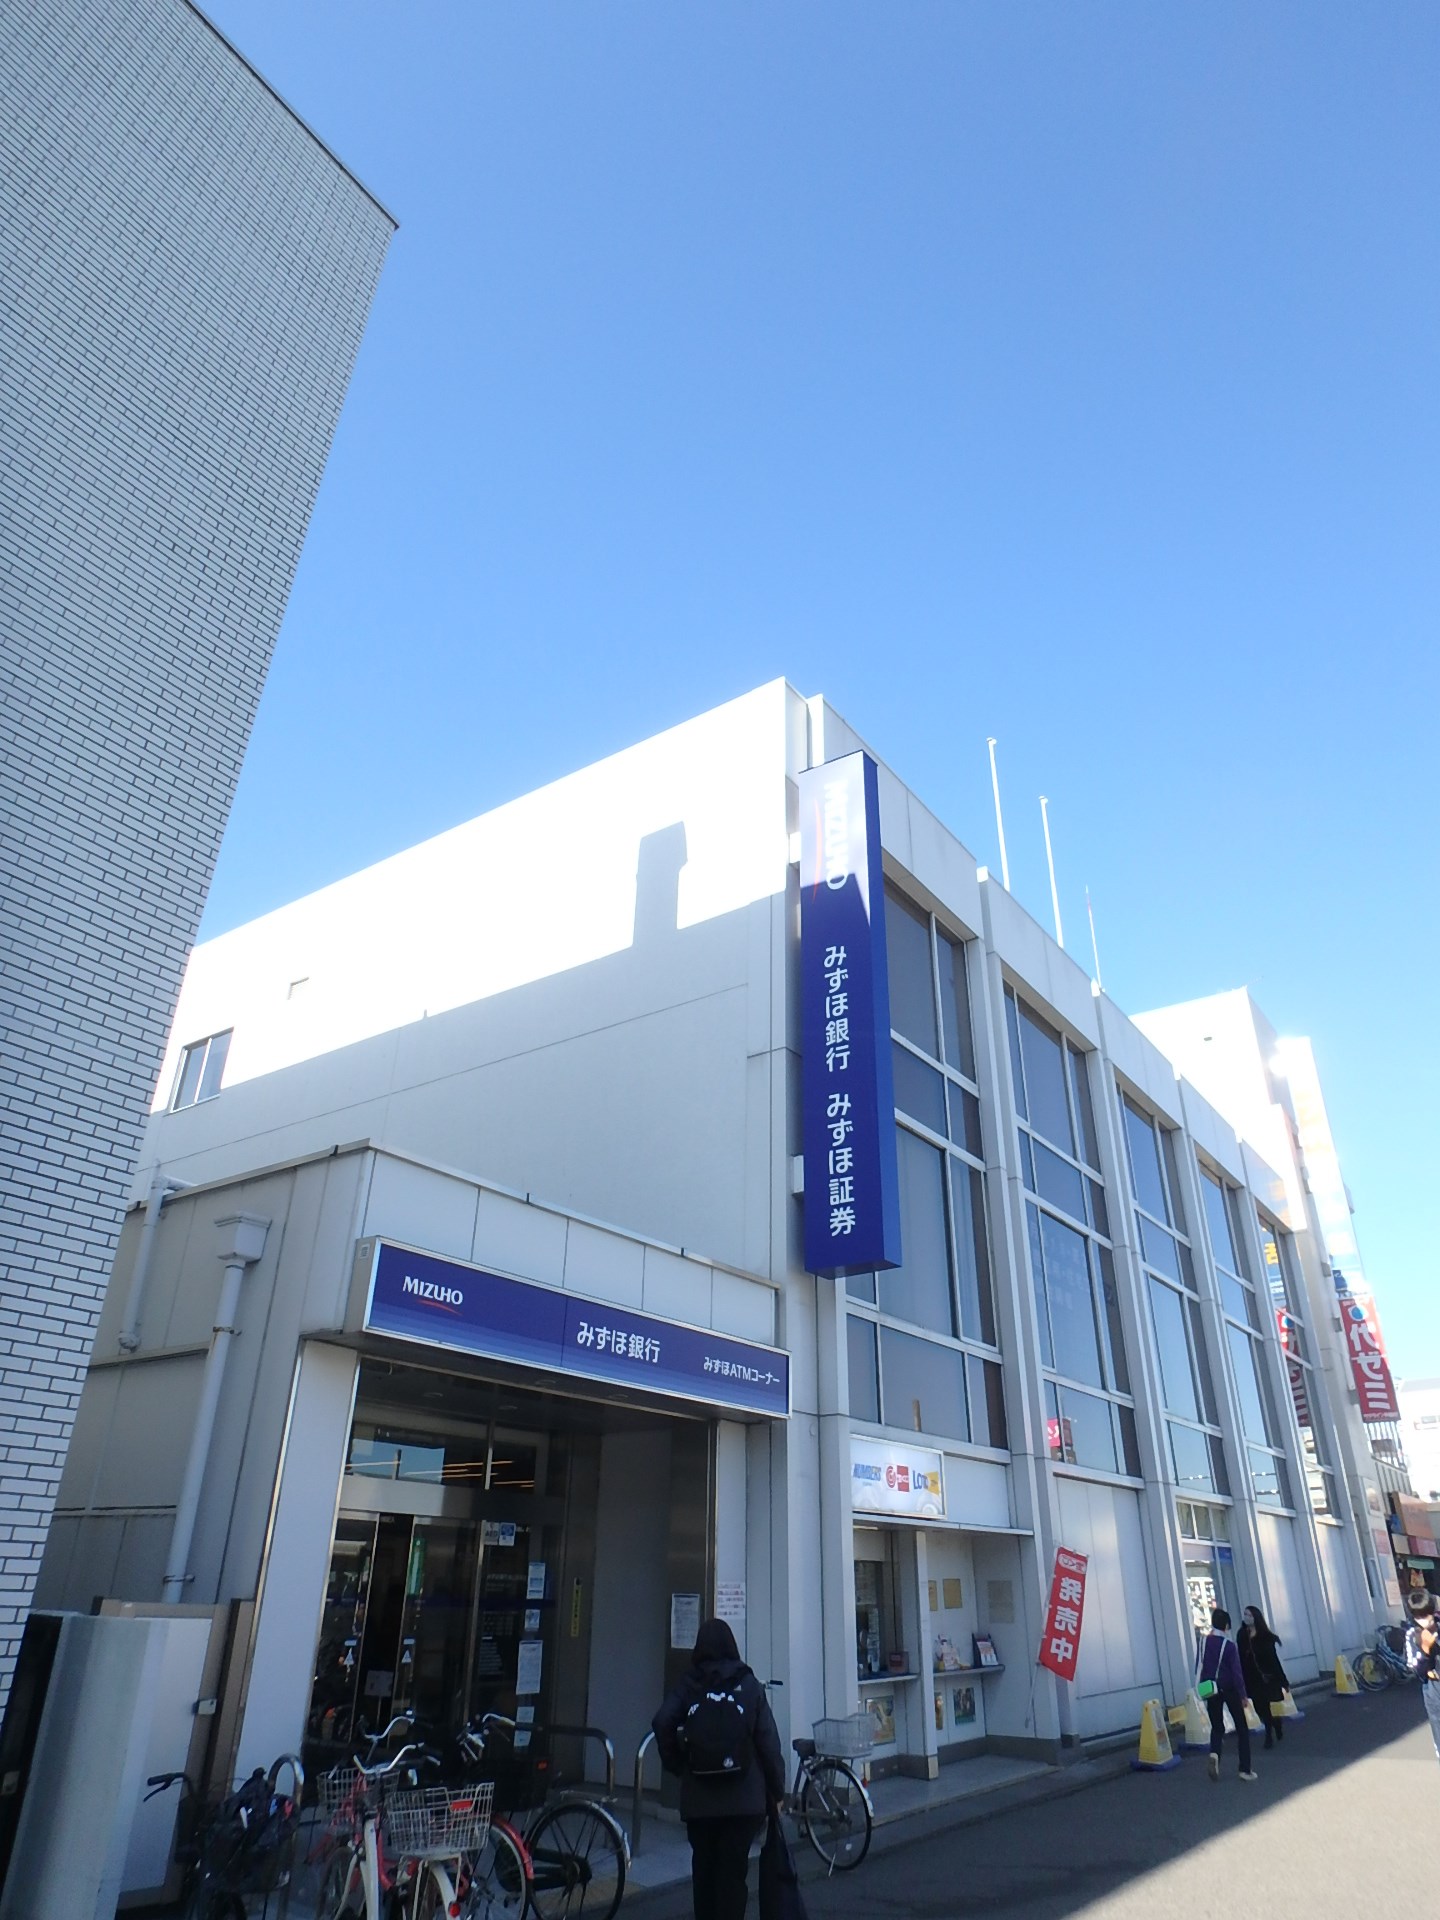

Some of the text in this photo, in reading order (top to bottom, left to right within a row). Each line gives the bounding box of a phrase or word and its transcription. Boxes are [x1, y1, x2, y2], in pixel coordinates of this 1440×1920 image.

[823, 945, 851, 1073] みずほ銀行
[825, 1093, 857, 1237] みずほ証券
[402, 1275, 464, 1306] MIZUHO
[576, 1321, 661, 1364] みずほ銀行
[703, 1355, 781, 1385] みずほATMコーナー
[1349, 1322, 1391, 1411] 代ゼミ
